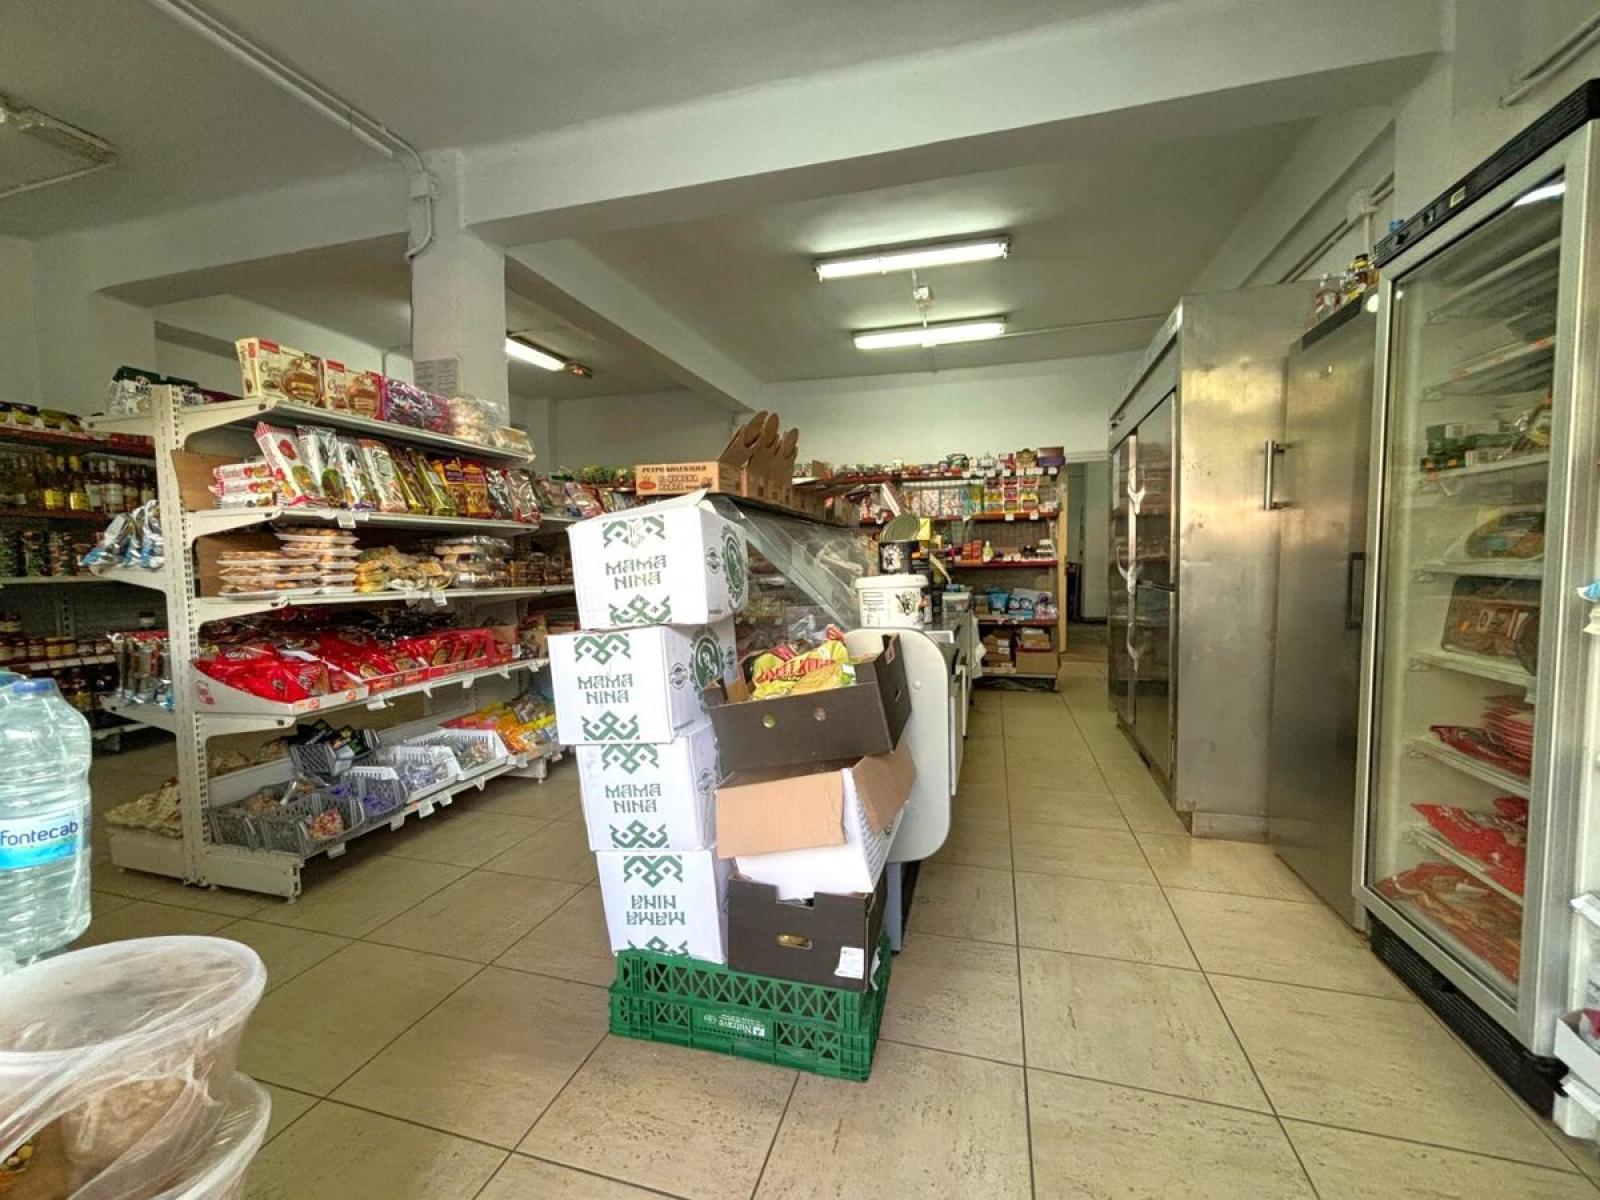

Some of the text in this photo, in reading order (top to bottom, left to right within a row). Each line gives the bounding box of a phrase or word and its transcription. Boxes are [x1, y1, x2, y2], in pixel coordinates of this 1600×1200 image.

[605, 554, 667, 576] MAMA
[613, 571, 662, 590] NINA
[577, 673, 633, 690] MAMA
[585, 689, 630, 705] NINA
[604, 783, 662, 799] MAMA
[613, 799, 658, 814] NINA
[0, 820, 79, 846] fontecab
[631, 894, 677, 909] NINA
[626, 910, 686, 926] MAMA
